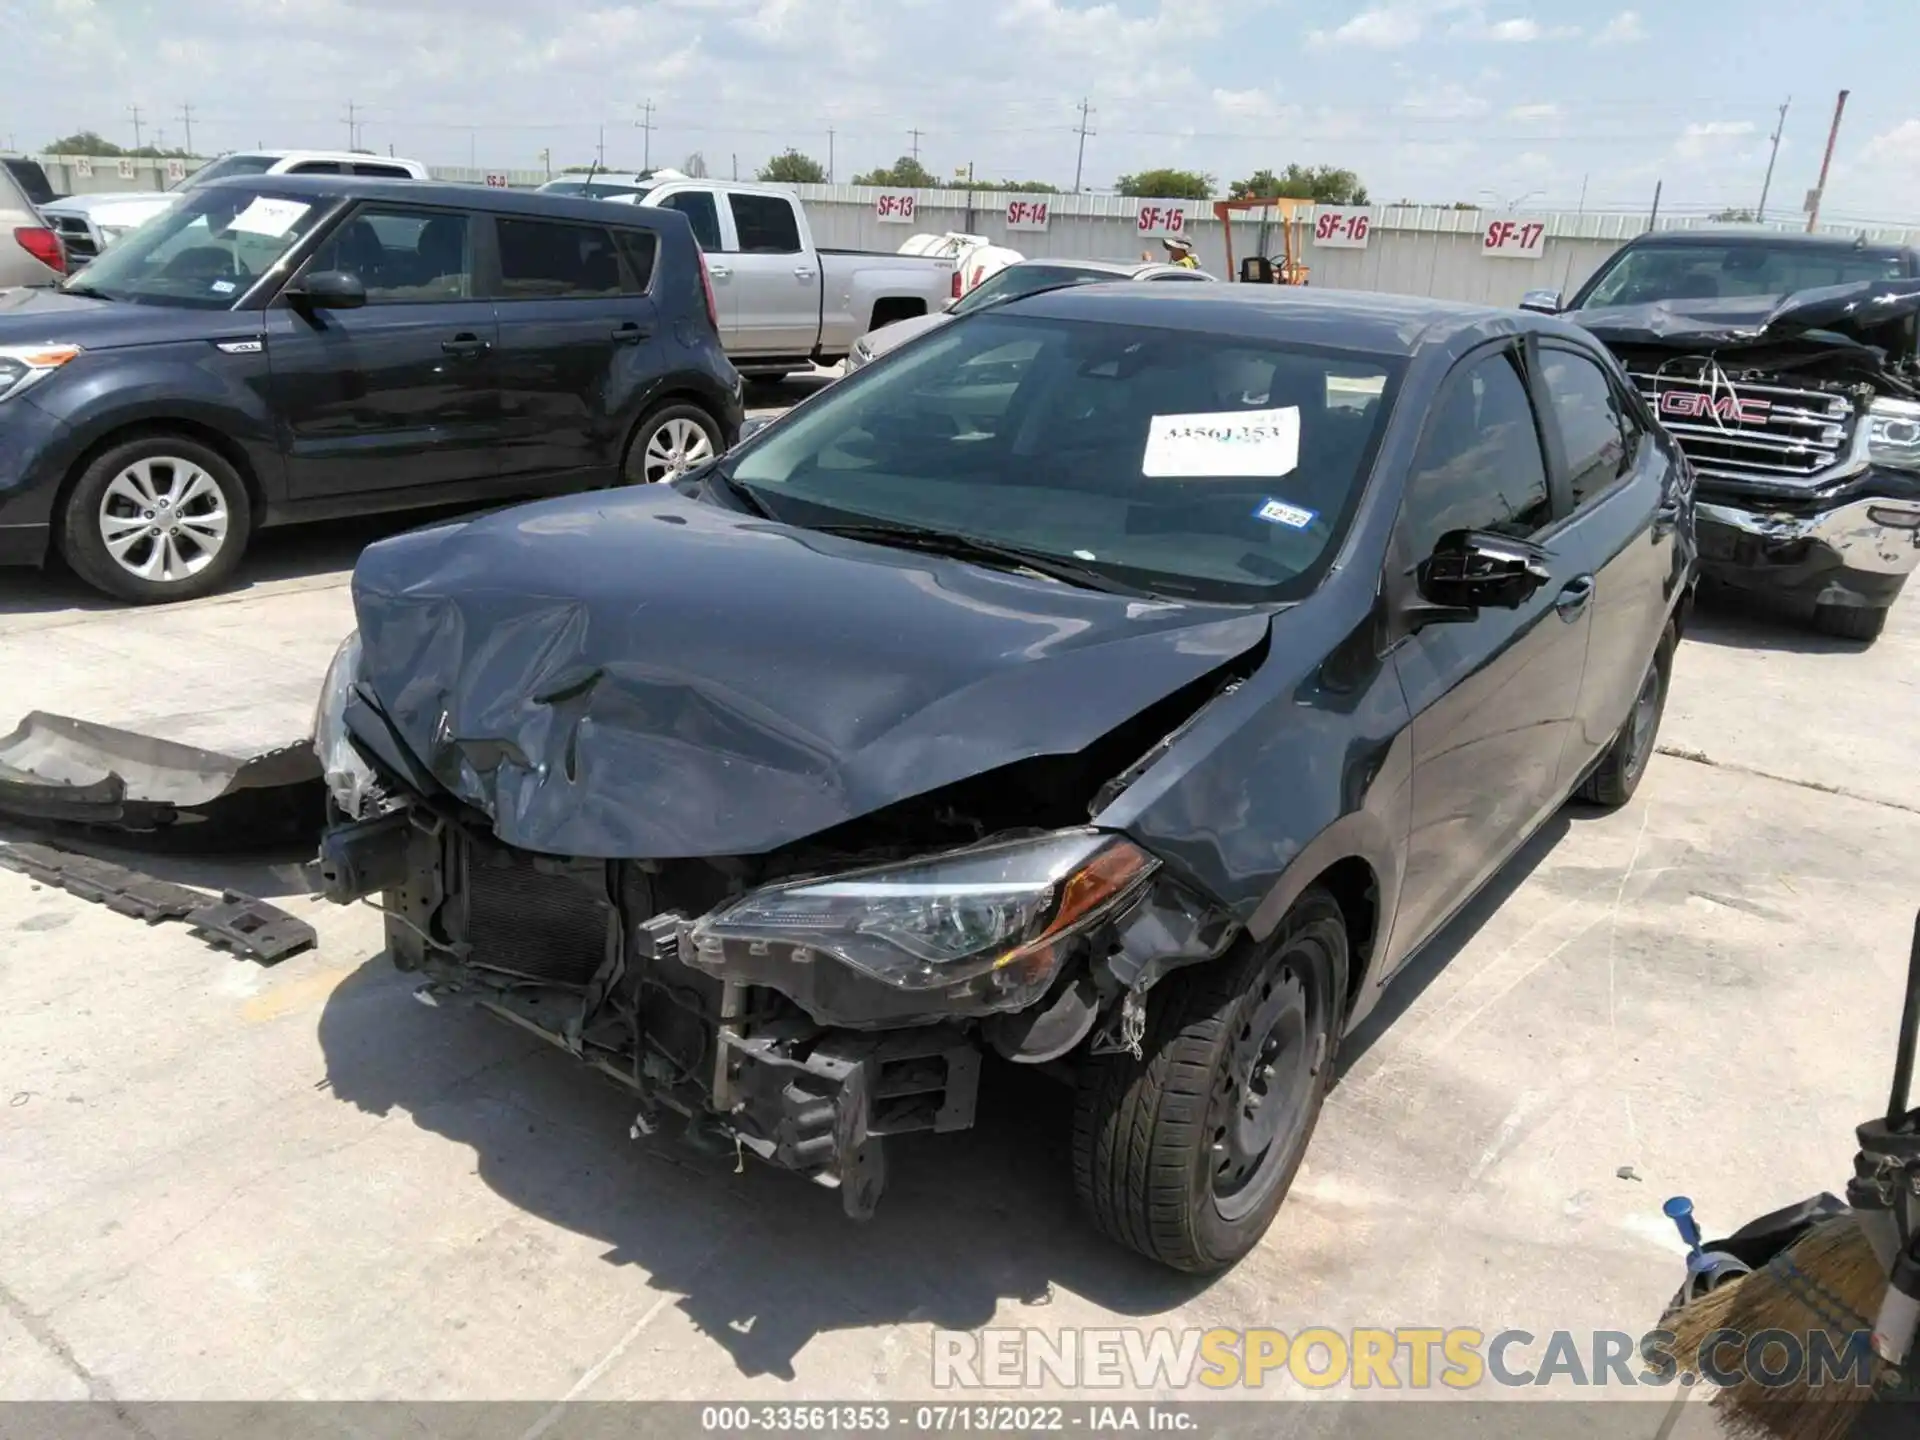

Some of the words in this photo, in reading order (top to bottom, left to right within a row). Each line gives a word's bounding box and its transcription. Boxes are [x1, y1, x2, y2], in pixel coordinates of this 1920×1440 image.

[877, 195, 914, 217] SF-13
[1007, 201, 1047, 225] SF-14
[1138, 207, 1184, 231] SF-15
[1315, 213, 1369, 240] SF-16
[1484, 221, 1544, 249] SF-17
[1661, 390, 1771, 424] GMC
